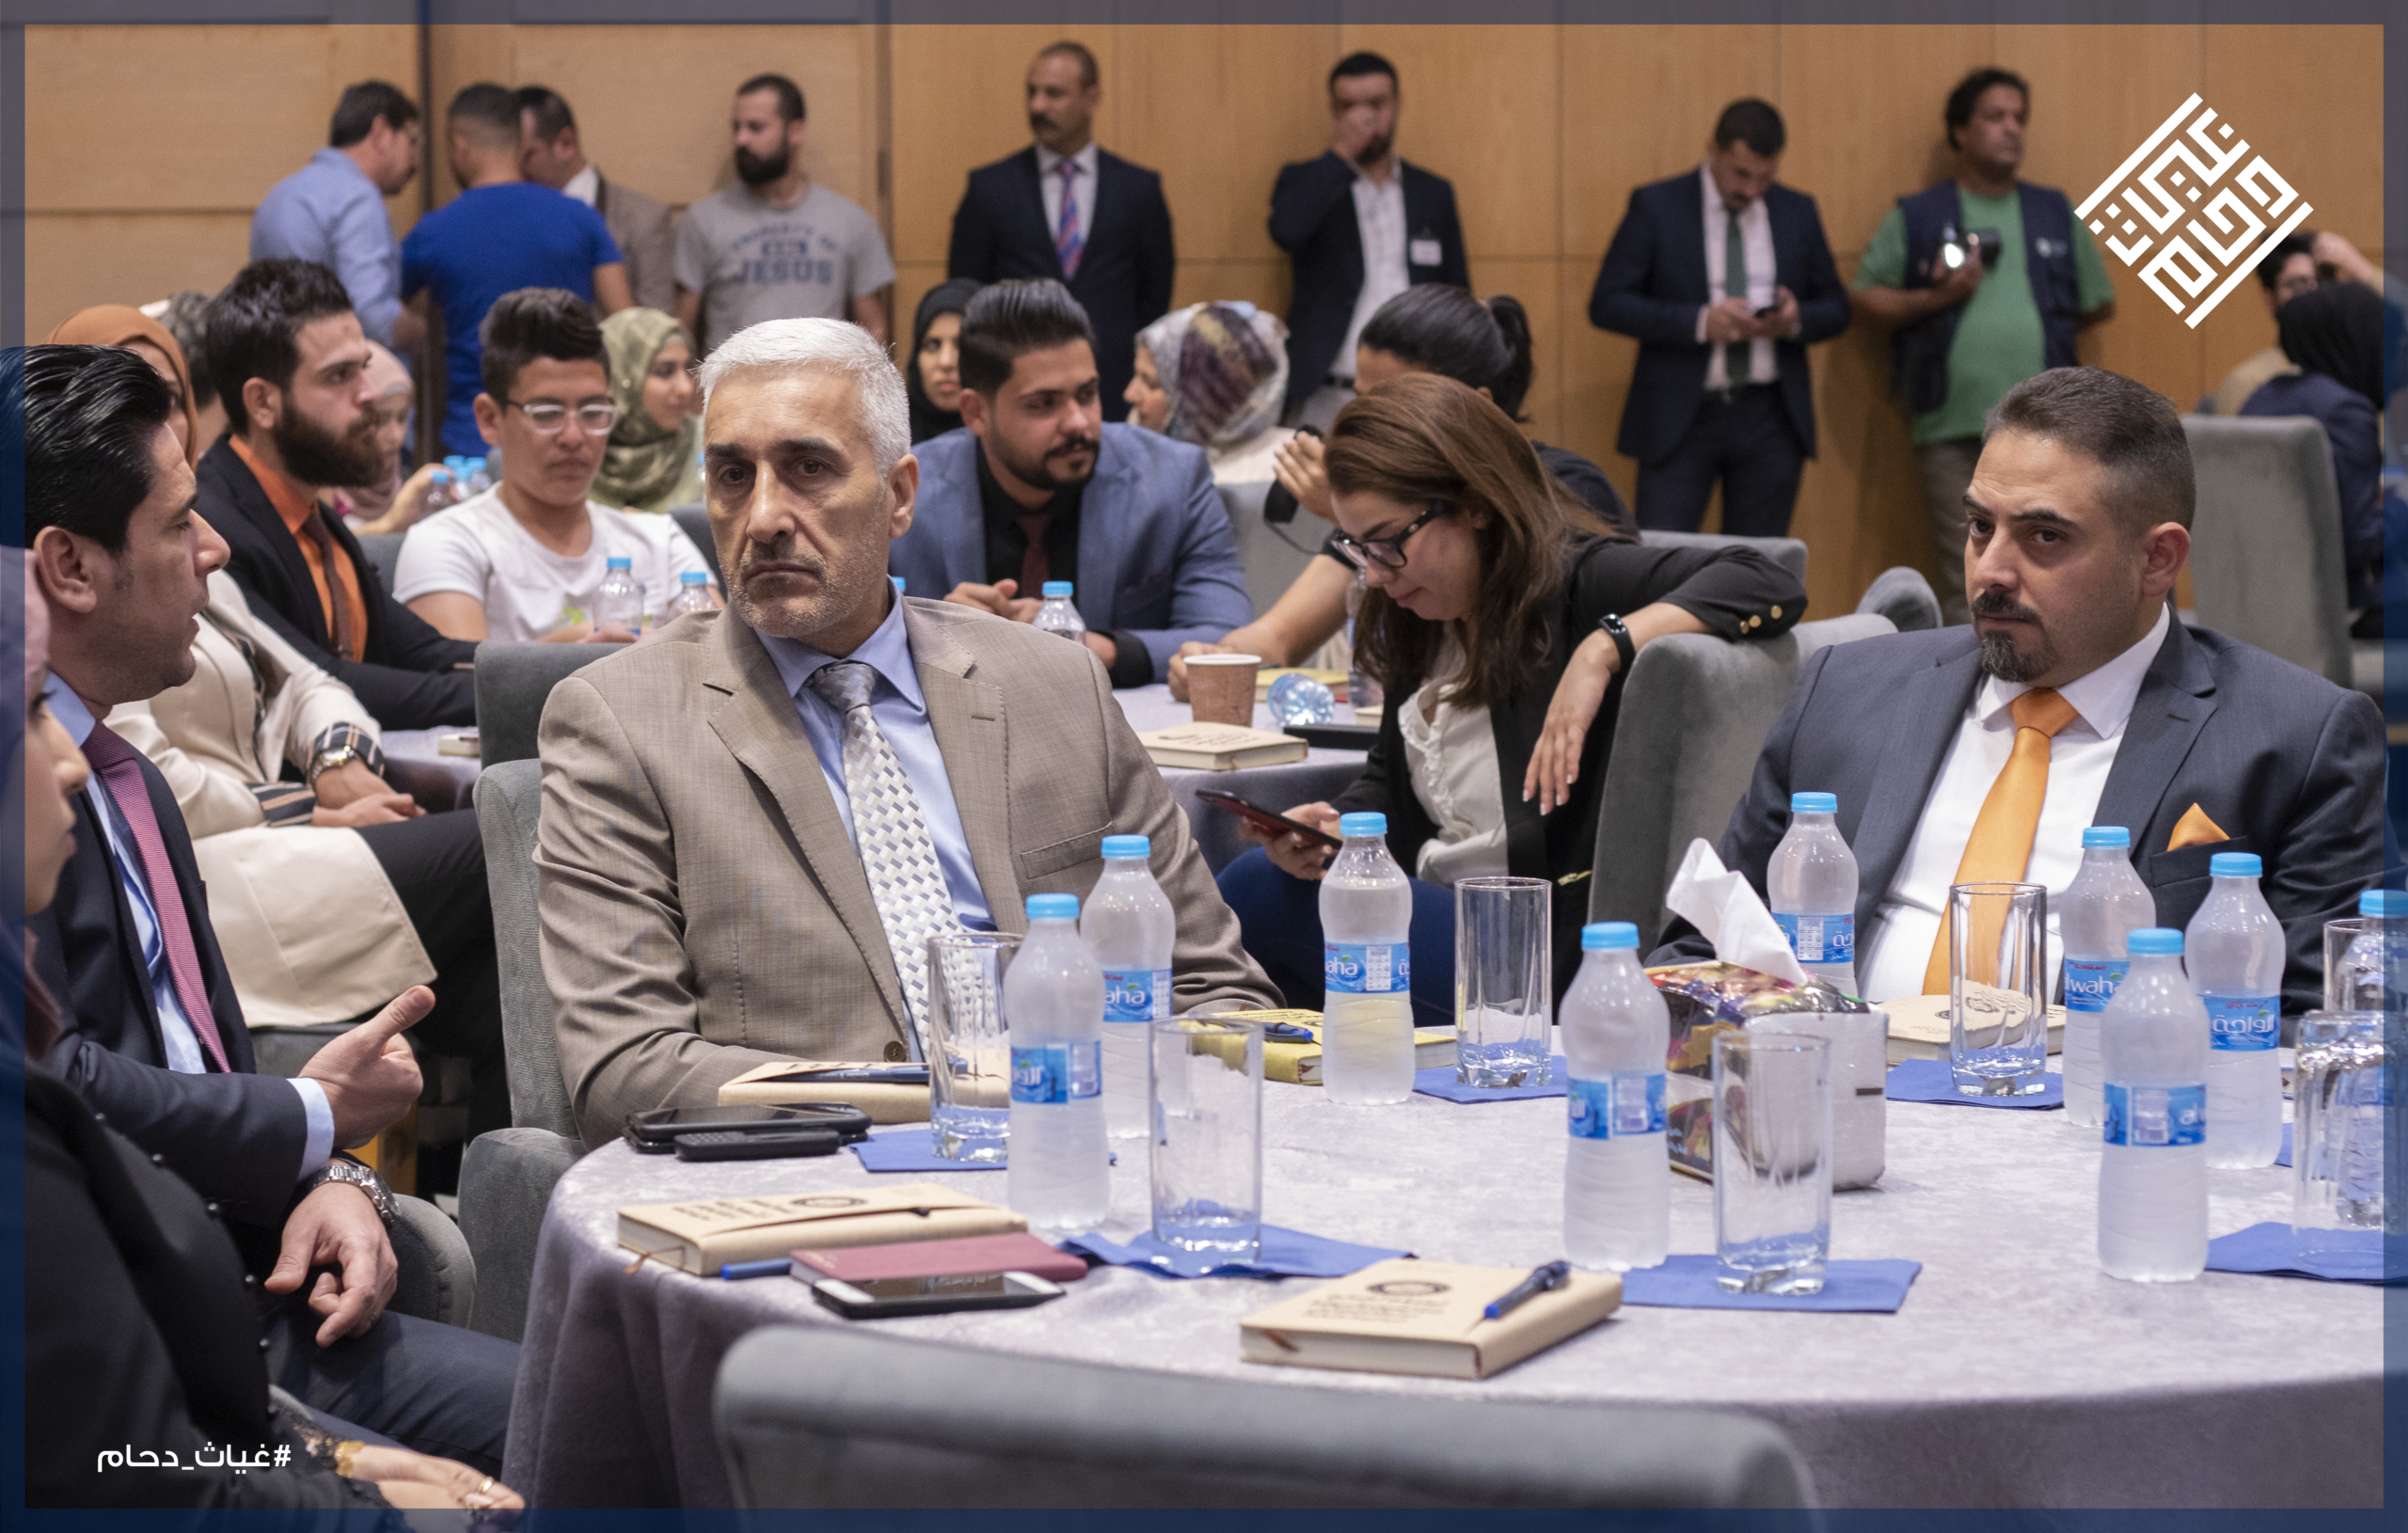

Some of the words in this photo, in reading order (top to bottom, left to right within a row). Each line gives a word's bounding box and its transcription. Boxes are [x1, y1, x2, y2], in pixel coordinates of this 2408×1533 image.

[1324, 956, 1359, 976] aha
[2065, 972, 2124, 994] lwah
[1105, 984, 1147, 1005] aha
